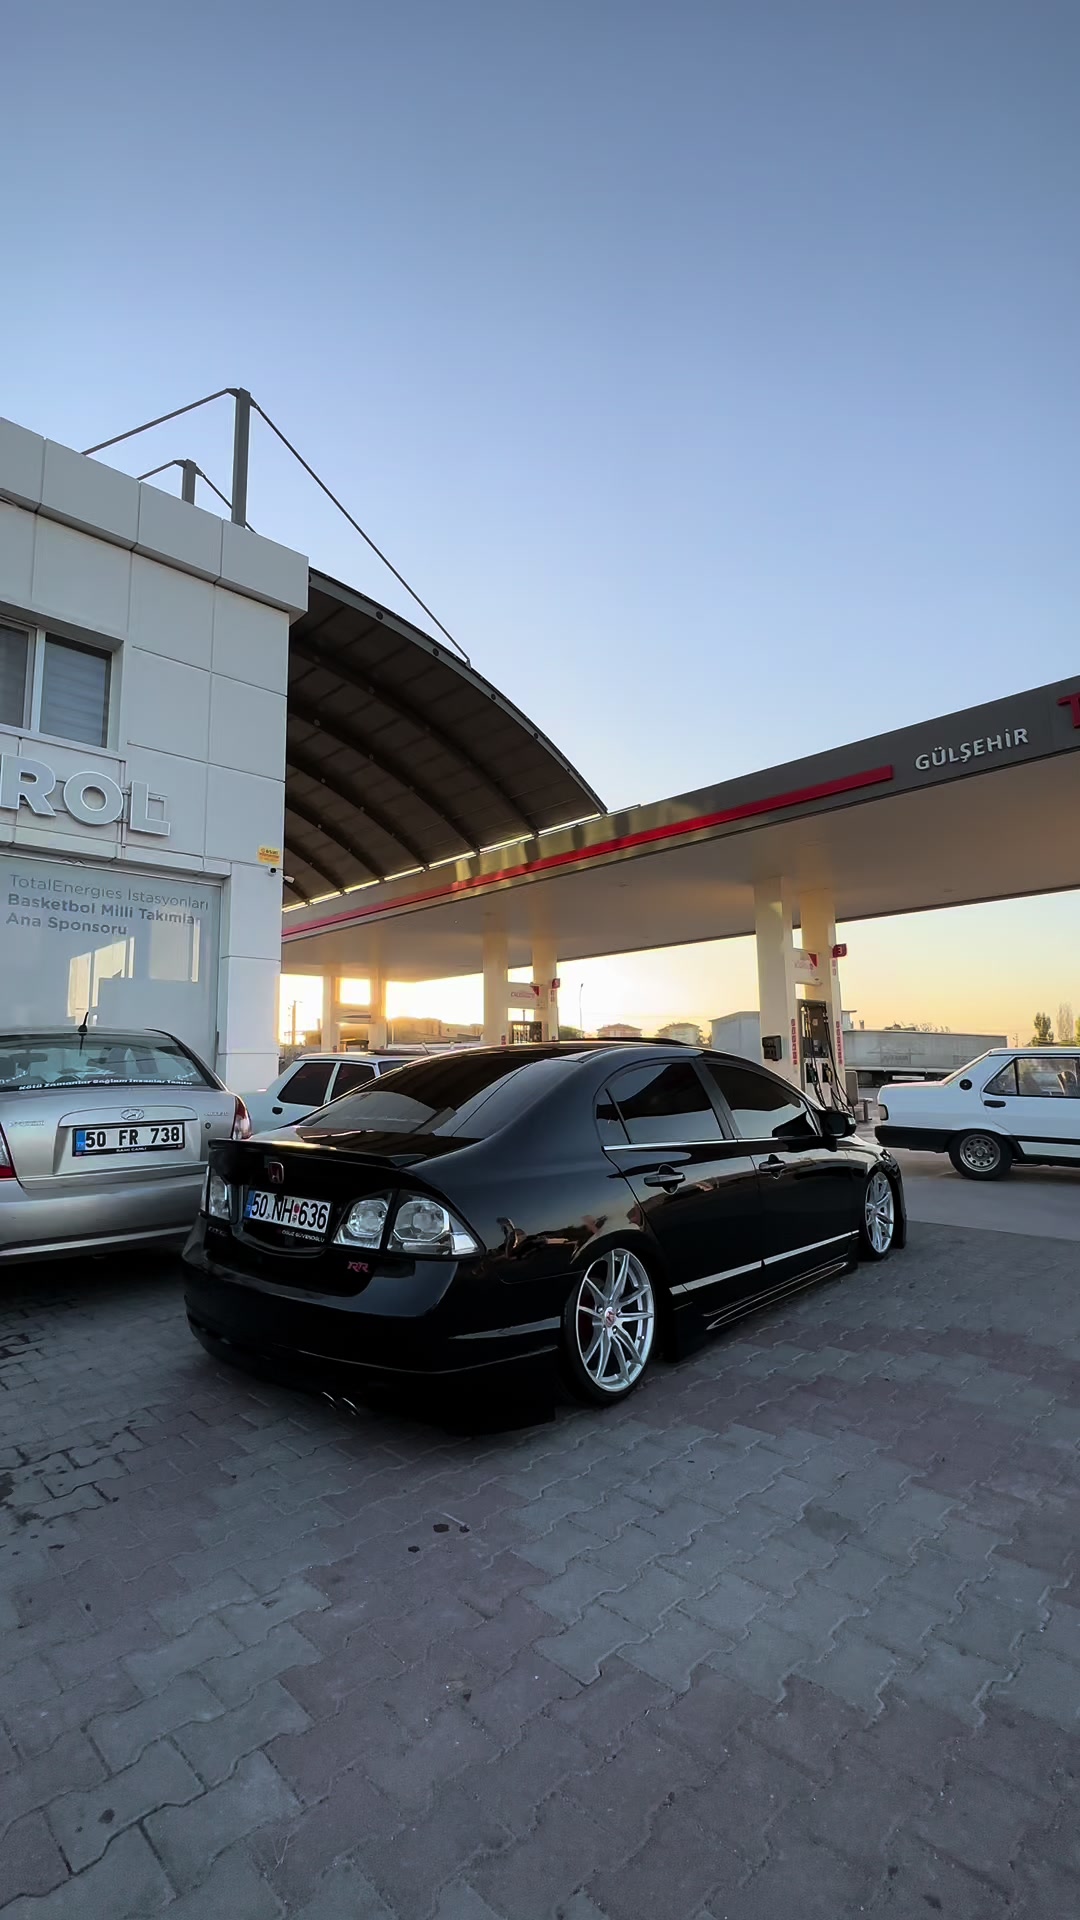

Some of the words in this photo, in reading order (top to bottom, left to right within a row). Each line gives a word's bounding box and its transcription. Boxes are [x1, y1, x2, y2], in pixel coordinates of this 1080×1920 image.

[915, 728, 1029, 770] GÜLŞEHİR
[9, 873, 122, 900] TotalEnergies
[8, 893, 95, 915] Basketbol
[101, 904, 133, 918] Milli
[6, 912, 41, 928] Ana
[47, 916, 128, 936] Sponsoru
[85, 1131, 106, 1149] 50
[118, 1129, 139, 1147] FR
[150, 1126, 180, 1145] 738
[251, 1193, 269, 1218] 50
[272, 1194, 295, 1224] NH
[298, 1201, 328, 1230] 636
